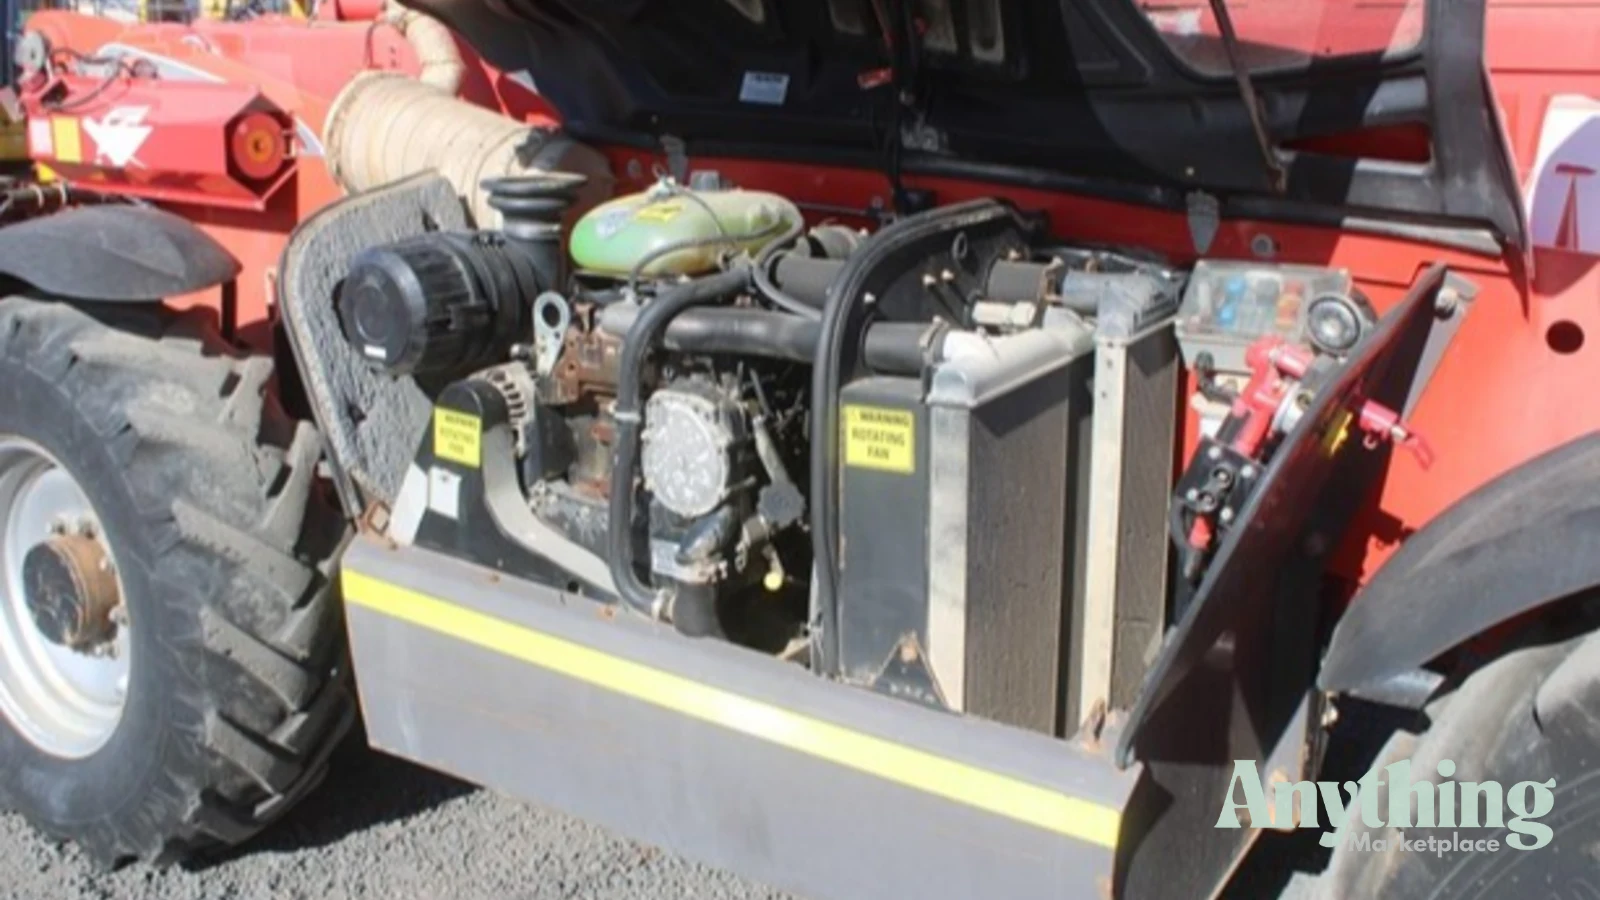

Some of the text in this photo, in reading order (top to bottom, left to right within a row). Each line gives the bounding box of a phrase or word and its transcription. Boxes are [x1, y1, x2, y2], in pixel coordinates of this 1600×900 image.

[860, 410, 910, 429] WARNING
[852, 426, 905, 448] ROTATING
[867, 445, 889, 461] FAN
